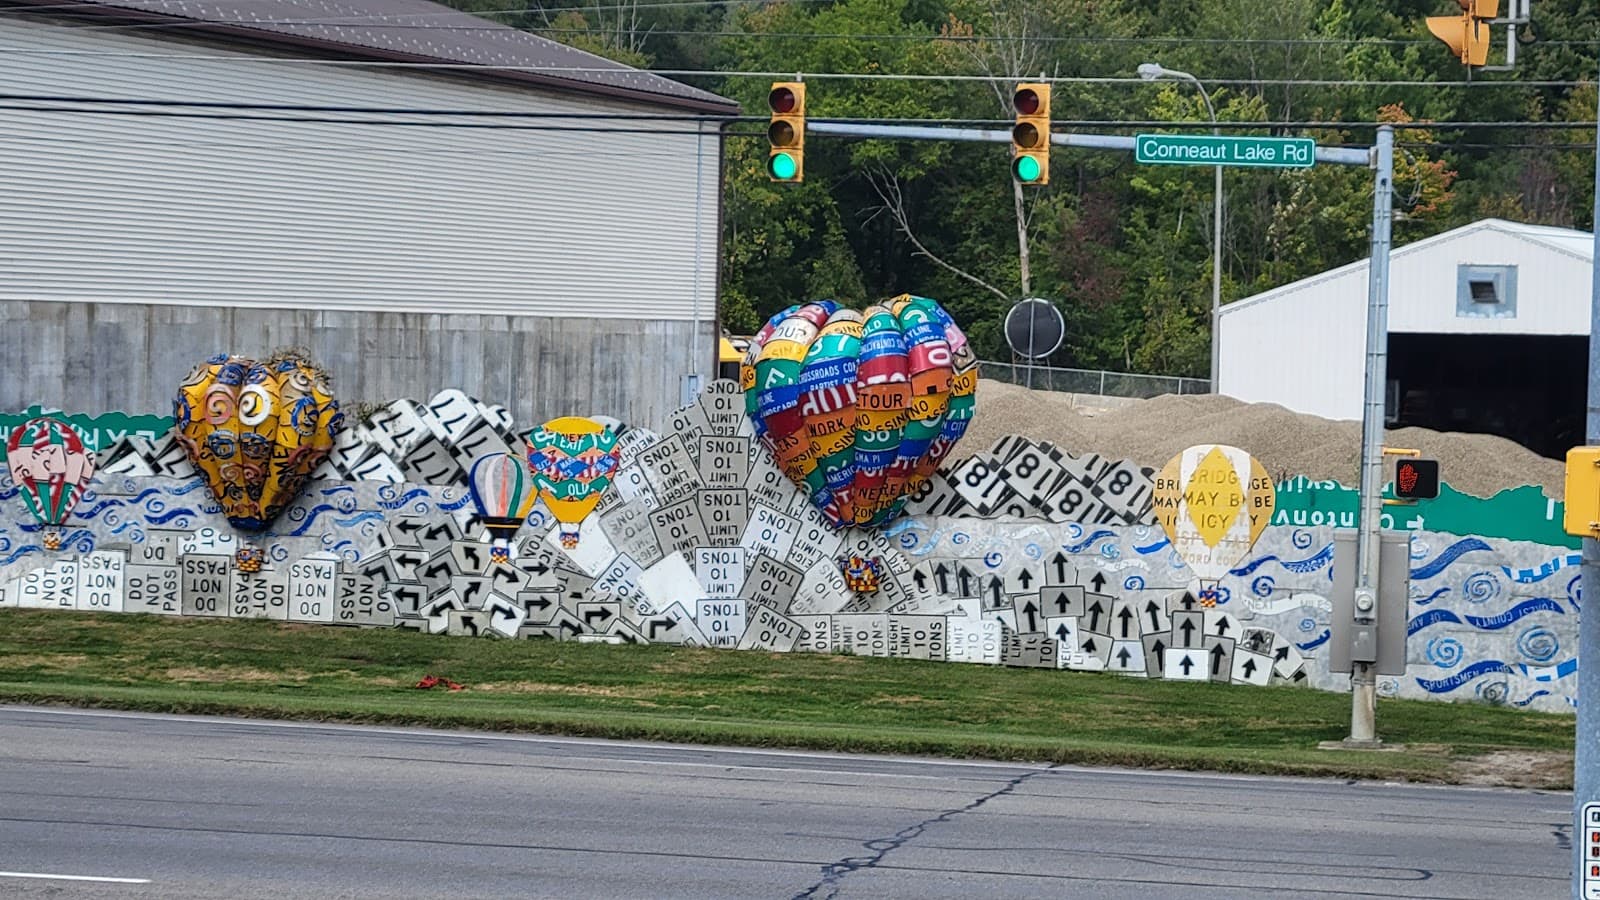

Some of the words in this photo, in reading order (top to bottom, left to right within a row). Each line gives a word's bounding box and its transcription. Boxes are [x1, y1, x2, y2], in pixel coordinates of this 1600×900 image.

[1143, 140, 1226, 159] Conneaut
[1234, 144, 1276, 160] Lake
[1283, 144, 1308, 161] Rd
[715, 398, 733, 409] 10
[857, 393, 902, 408] ETOUR
[910, 400, 928, 415] NO
[808, 417, 846, 437] WORK
[643, 442, 680, 467] TONS
[705, 441, 743, 453] TONS
[660, 460, 679, 476] 10
[714, 457, 732, 469] 10
[662, 469, 690, 491] LIMIT
[709, 473, 738, 483] LIMIT
[704, 494, 742, 506] TONS
[1153, 496, 1181, 509] MAY
[1254, 496, 1273, 508] BE
[1184, 491, 1219, 506] MAY
[656, 505, 694, 527] TONS
[713, 510, 731, 522] 10
[758, 510, 793, 534] TONS
[1201, 514, 1230, 529] ICY
[671, 523, 689, 538] 10
[709, 525, 738, 535] LIMIT
[761, 529, 778, 544] 10
[808, 529, 825, 545] 10
[83, 557, 120, 570] PASS
[702, 552, 739, 564] TONS
[186, 560, 227, 575] PASS
[292, 564, 332, 579] PASS
[711, 568, 728, 580] 10
[759, 561, 795, 587] TONS
[25, 573, 38, 594] DO
[42, 569, 56, 600] NOT
[86, 574, 116, 588] NOT
[600, 561, 631, 593] TONS
[60, 565, 74, 606] PASS
[129, 578, 142, 600] DO
[147, 574, 160, 605] NOT
[163, 569, 177, 611] PASS
[191, 579, 221, 593] NOT
[296, 583, 326, 597] NOT
[617, 580, 635, 597] 10
[707, 583, 735, 593] LIMIT
[760, 579, 778, 595] 10
[90, 592, 110, 606] DO
[235, 573, 249, 615] PASS
[253, 578, 267, 611] NOT
[271, 585, 284, 607] DO
[341, 578, 356, 619] PASS
[359, 584, 373, 616] NOT
[196, 598, 216, 611] DO
[300, 602, 320, 615] DO
[703, 604, 740, 616] TONS
[712, 620, 729, 632] 10
[759, 612, 794, 640] TONS
[1475, 612, 1513, 627] COUNTY
[760, 630, 777, 646] 10
[815, 621, 827, 649] ONS
[901, 626, 910, 656] LIMIT
[914, 630, 926, 647] 10
[930, 622, 942, 659] TONS
